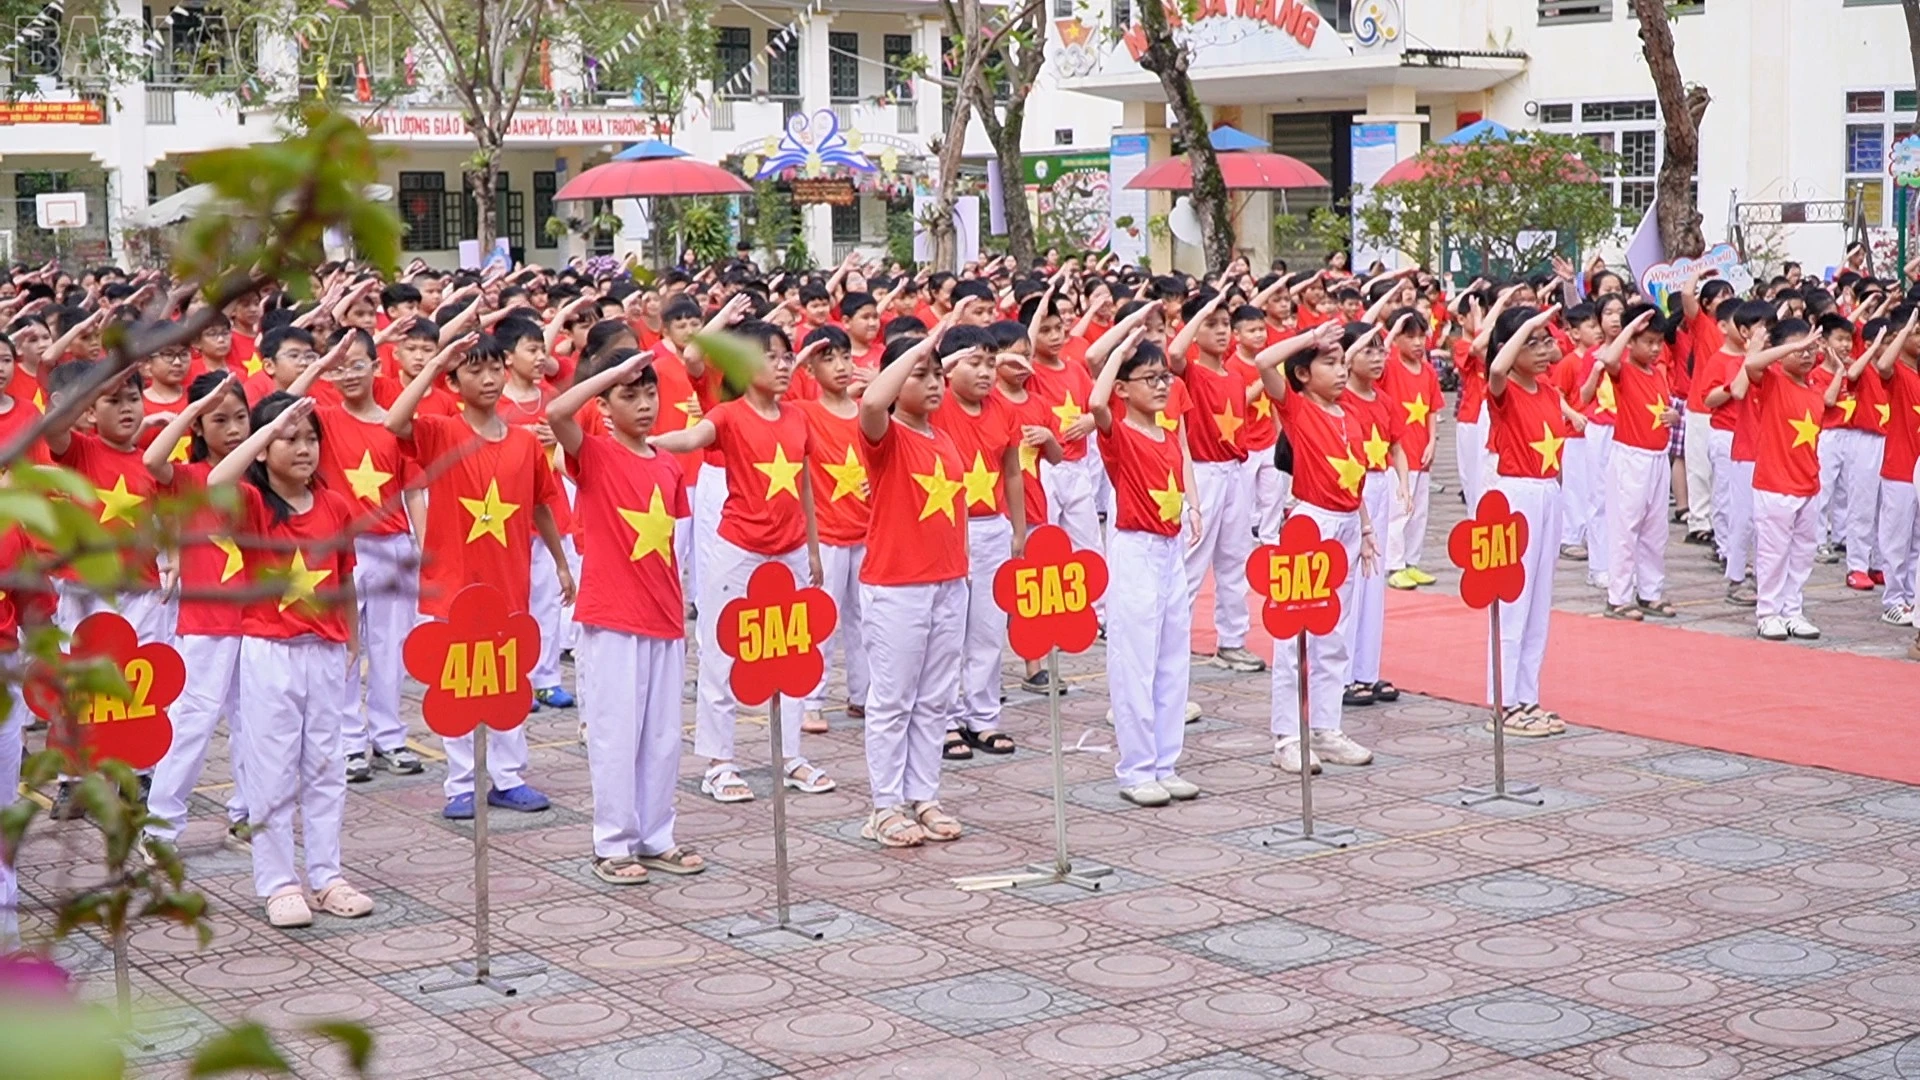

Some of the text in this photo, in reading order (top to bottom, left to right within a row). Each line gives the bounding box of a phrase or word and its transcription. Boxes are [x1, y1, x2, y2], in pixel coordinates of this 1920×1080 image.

[1471, 521, 1517, 571] 5A1
[1015, 562, 1087, 618] 5A3
[1269, 551, 1331, 602] 5A2
[738, 602, 811, 662] 5A4
[440, 637, 517, 698] 4A1
